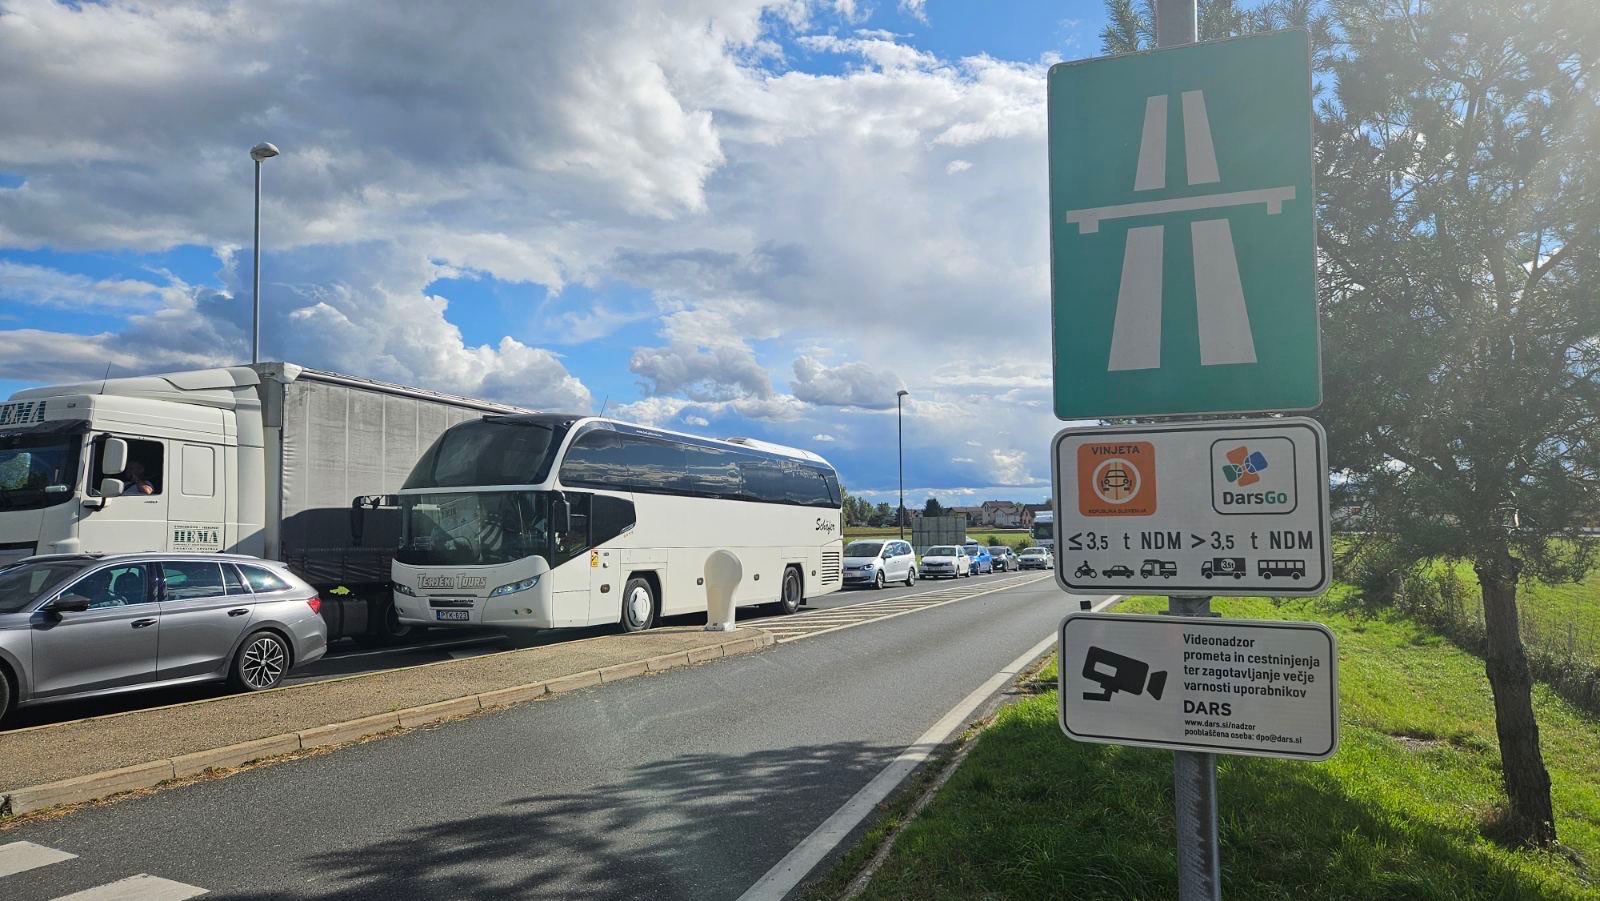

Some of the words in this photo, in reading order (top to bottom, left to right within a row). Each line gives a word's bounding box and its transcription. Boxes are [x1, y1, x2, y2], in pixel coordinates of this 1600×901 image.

[0, 401, 46, 425] EMA
[1091, 446, 1140, 455] VINJETA
[1222, 491, 1288, 505] DarsGo
[173, 530, 218, 543] HEMA
[1123, 533, 1130, 549] t
[1141, 532, 1181, 549] NDM
[1250, 532, 1258, 549] t
[1269, 531, 1313, 549] NDM
[1183, 633, 1255, 648] Videonadzor
[1184, 651, 1231, 662] prometa
[1234, 652, 1244, 662] in
[1247, 654, 1320, 669] cestninjenja
[1184, 665, 1200, 675] ter
[1202, 667, 1280, 683] zagotavljanje
[1283, 671, 1314, 684] večje
[1184, 682, 1230, 693] varnosti
[1233, 685, 1306, 698] uporabnikov
[1183, 700, 1232, 716] DARS
[1185, 720, 1256, 730] www.dars.si/nadzor
[1185, 729, 1229, 739] pooblaščena
[1231, 732, 1254, 740] oseba:
[1256, 734, 1302, 744] dpo@dars.si
